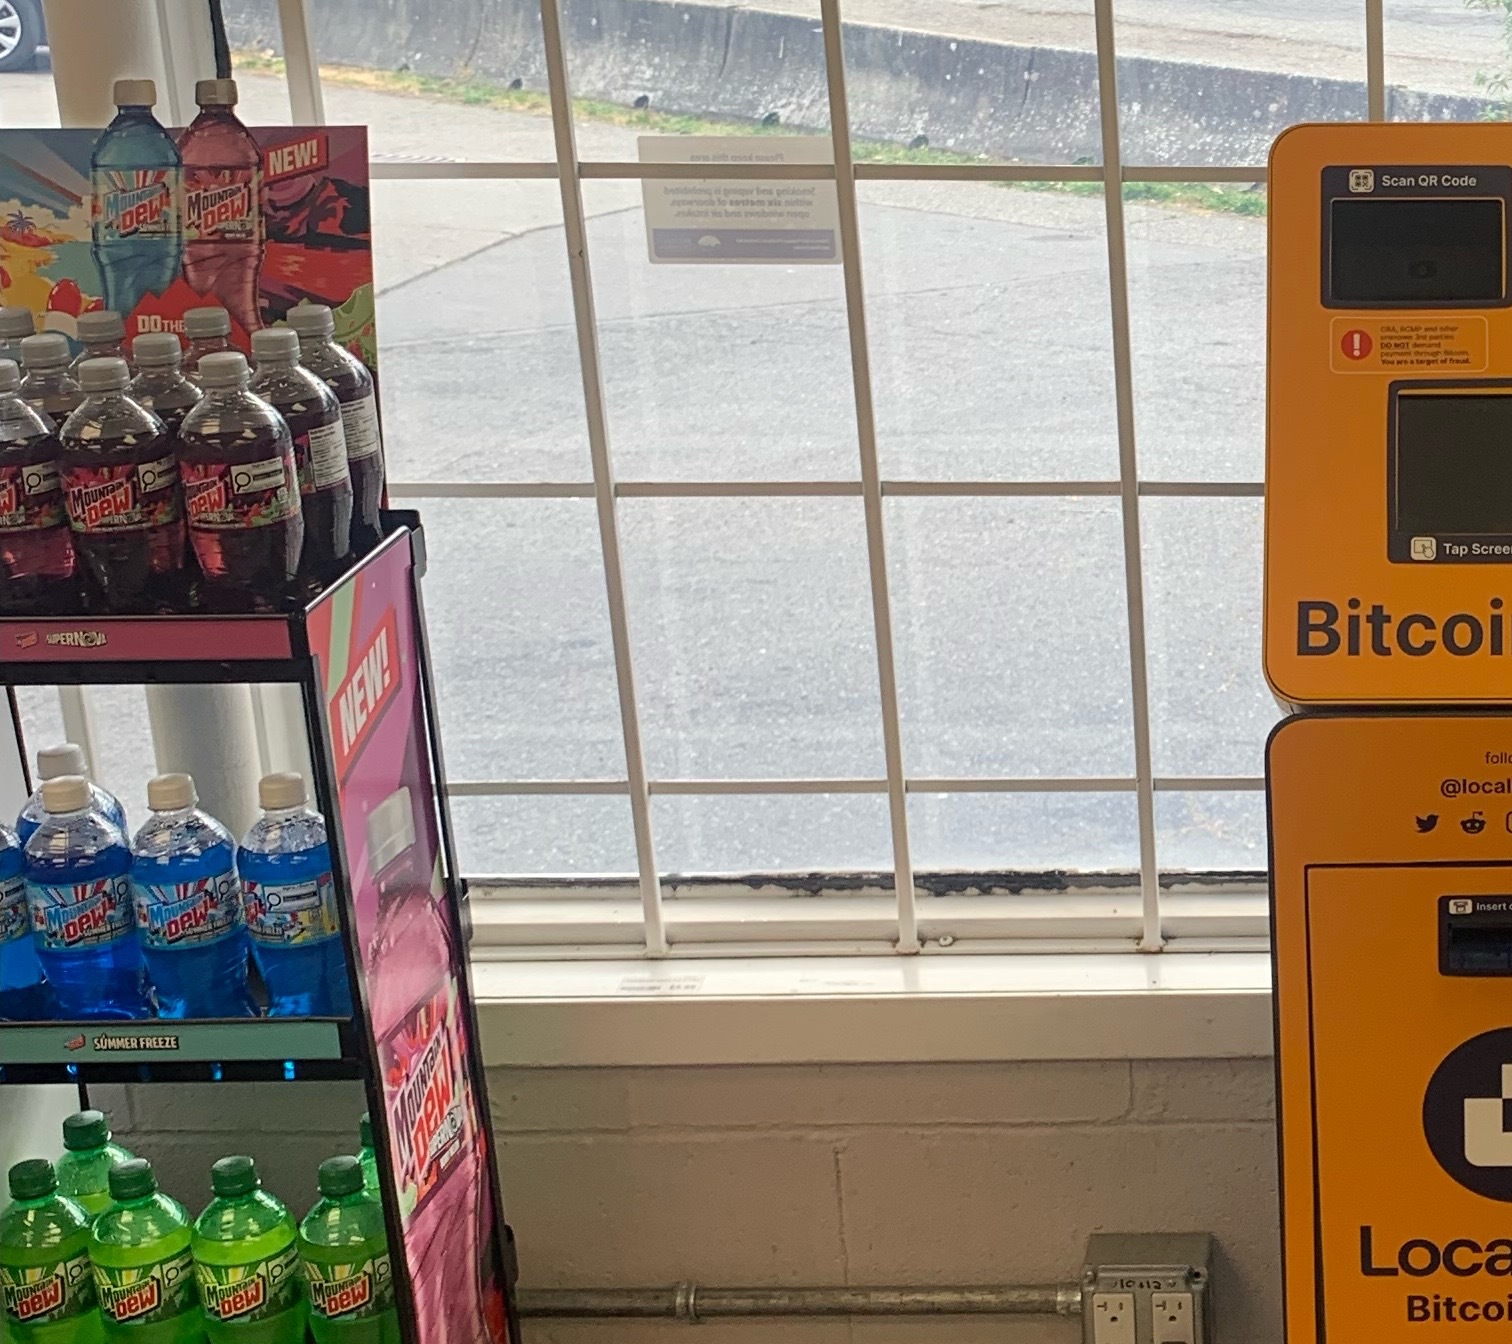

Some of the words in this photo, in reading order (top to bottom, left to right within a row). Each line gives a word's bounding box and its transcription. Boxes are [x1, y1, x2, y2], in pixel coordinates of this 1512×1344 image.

[268, 139, 319, 177] NEW!
[1381, 173, 1414, 188] Scan
[1417, 173, 1439, 189] QR
[1441, 173, 1477, 188] Code
[137, 315, 162, 333] DO
[1443, 542, 1470, 558] Tap
[338, 625, 392, 757] NEW!
[1476, 902, 1507, 912] Insert
[139, 1036, 178, 1050] FREEZE
